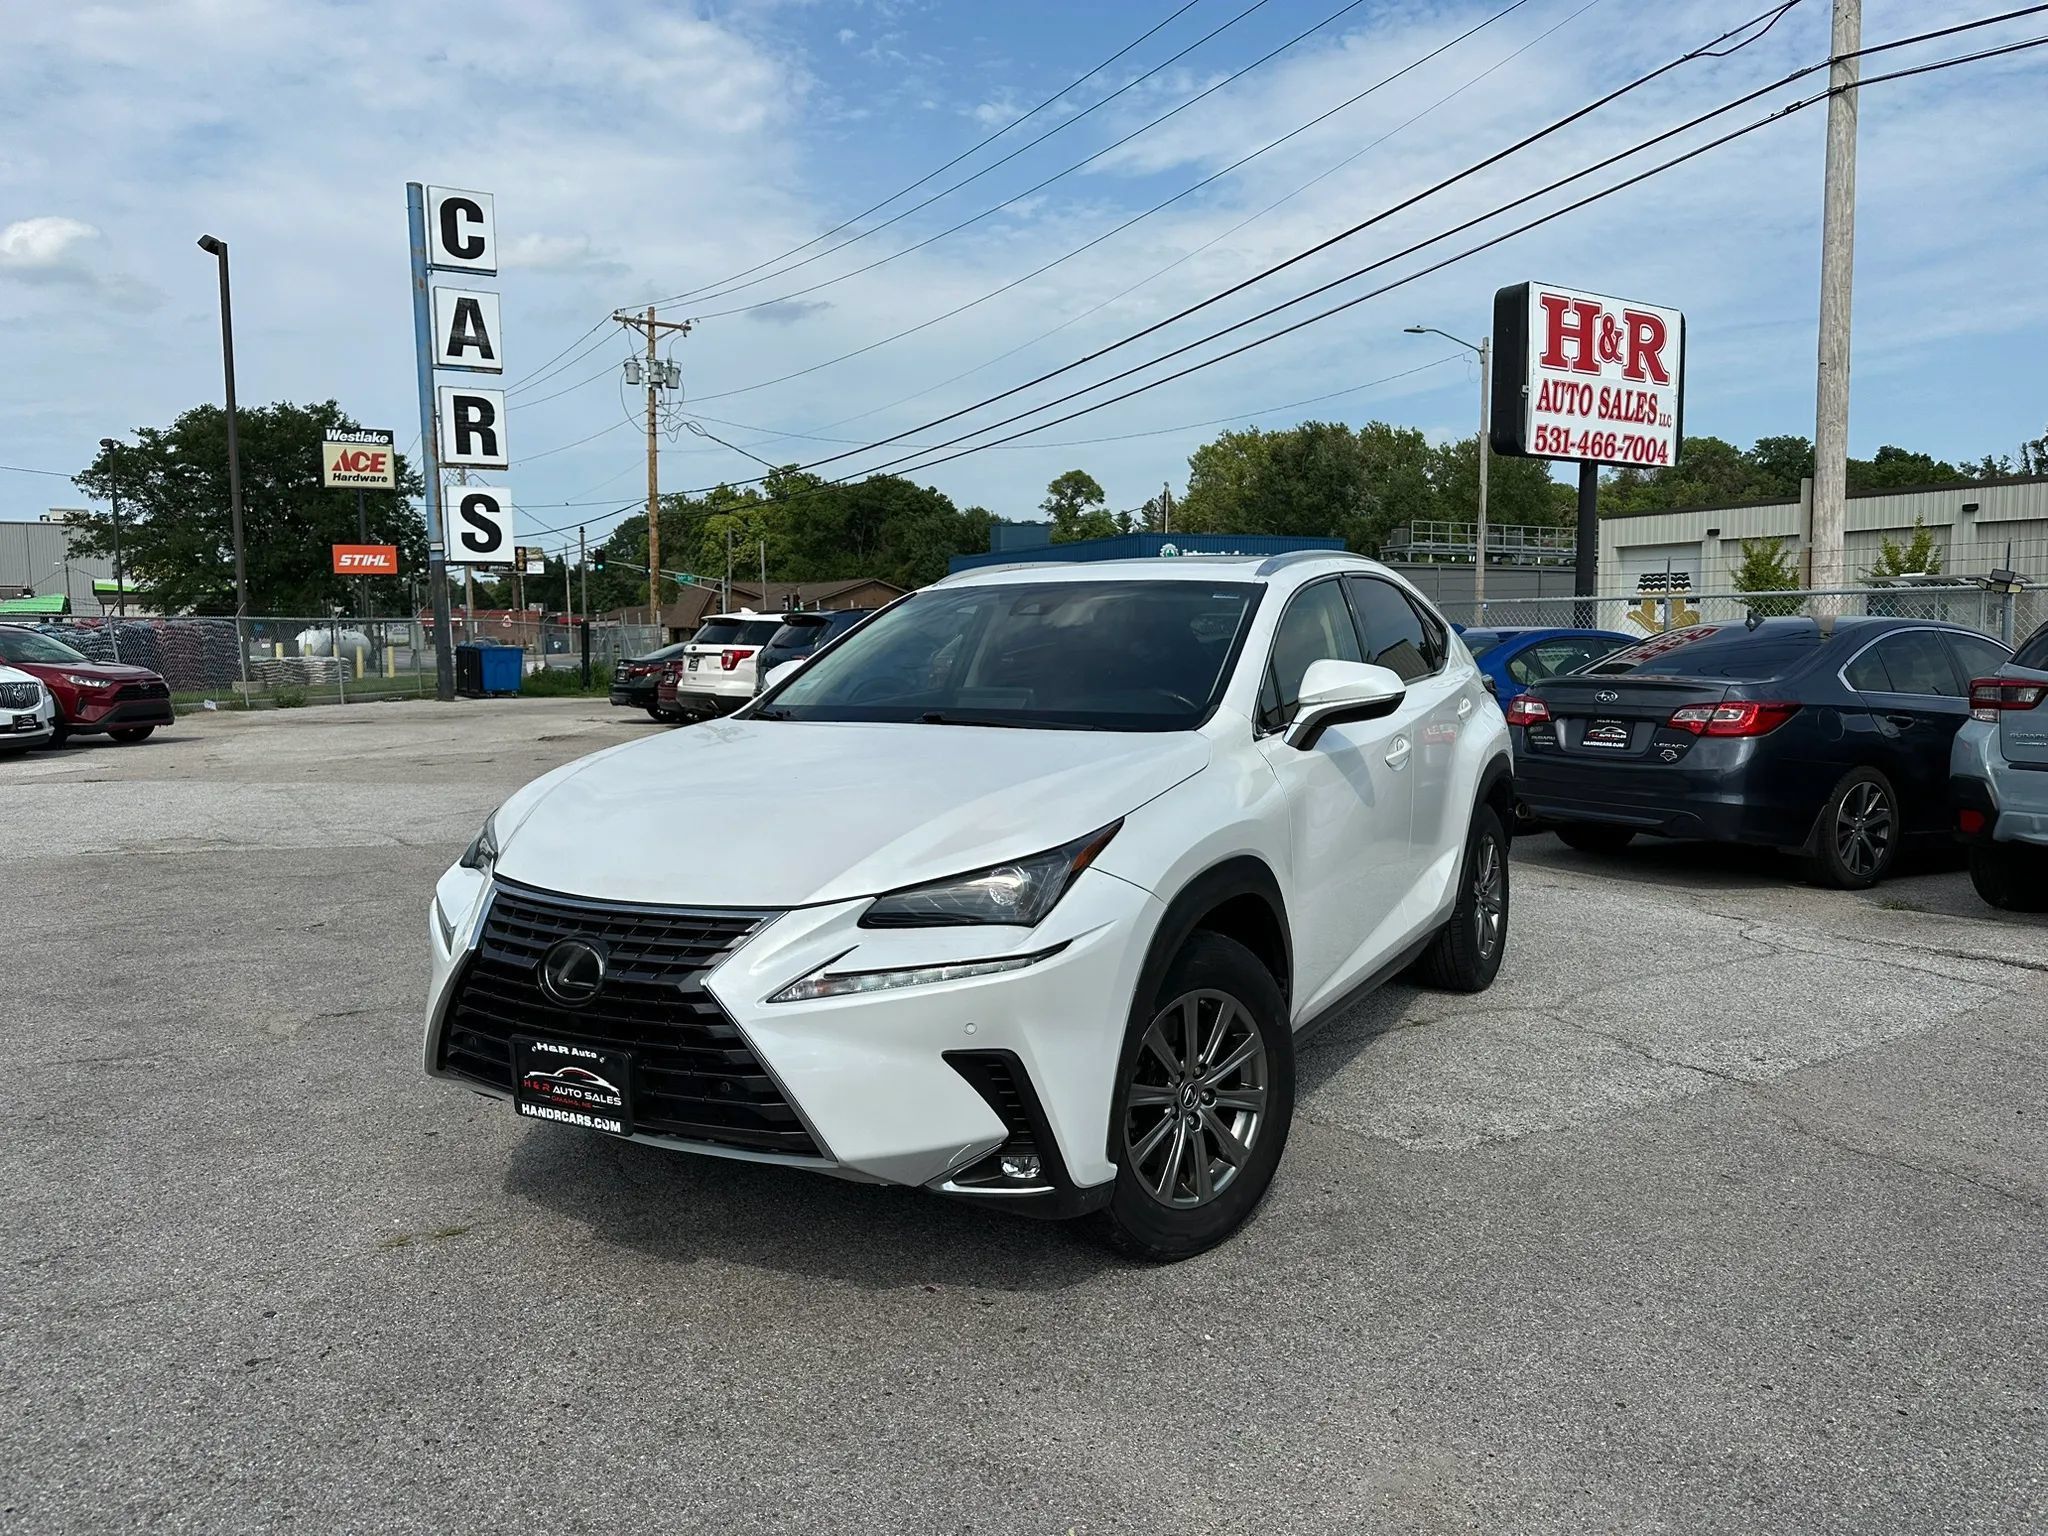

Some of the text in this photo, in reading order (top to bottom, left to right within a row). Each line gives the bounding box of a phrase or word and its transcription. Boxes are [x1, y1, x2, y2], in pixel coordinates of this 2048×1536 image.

[1540, 292, 1671, 386] H&R
[440, 196, 503, 553] CARS
[1536, 378, 1673, 428] AUTO SALES LLC
[325, 429, 389, 444] Westlake
[1534, 423, 1669, 465] 531-466-7004
[332, 449, 387, 473] ACE
[333, 473, 388, 483] Hardware
[339, 554, 390, 567] STIHL
[571, 1048, 598, 1059] Auto
[552, 1085, 583, 1098] AUTO
[584, 1091, 622, 1106] SALES
[521, 1103, 621, 1133] HANDRCARS.COM
